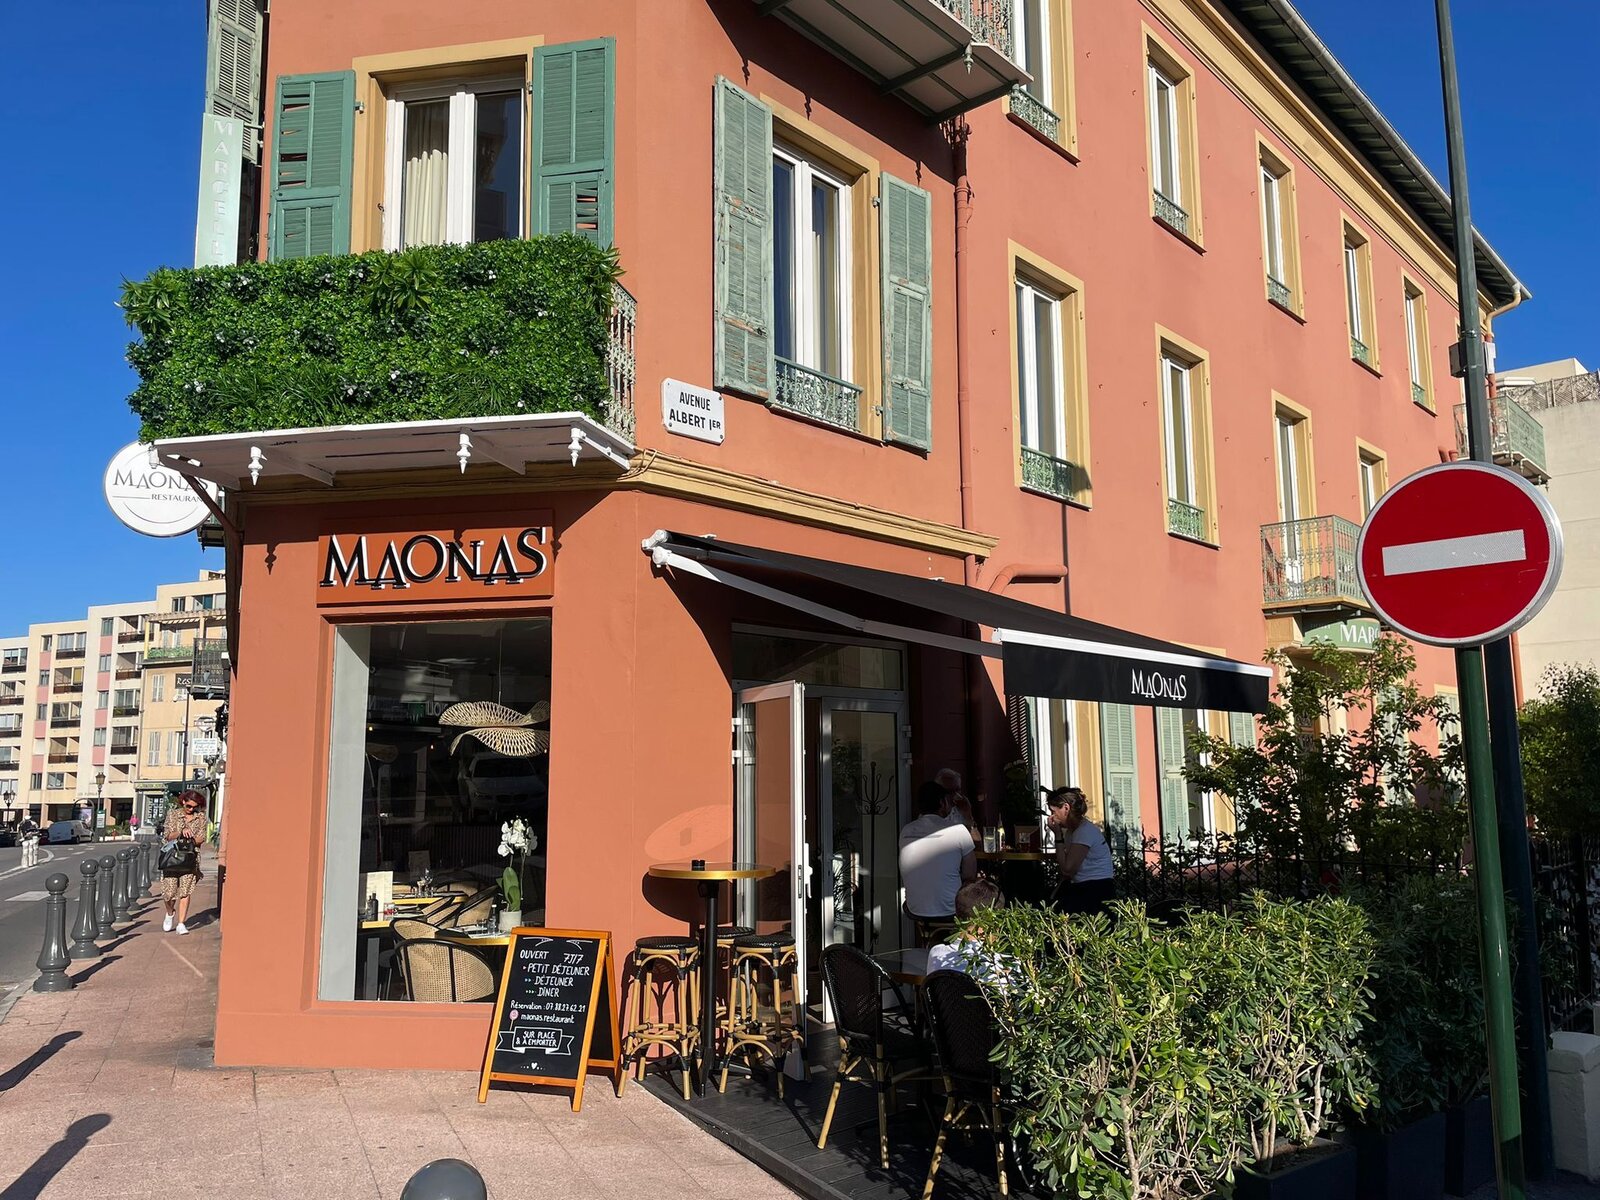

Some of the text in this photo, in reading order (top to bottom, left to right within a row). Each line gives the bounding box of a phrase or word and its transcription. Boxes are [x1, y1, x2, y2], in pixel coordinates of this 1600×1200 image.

[679, 391, 711, 412] AVENUE
[669, 408, 706, 429] ALBERT
[151, 493, 204, 503] RESTAURAN
[319, 526, 548, 590] MAONAS
[1131, 668, 1187, 701] MAONAS
[519, 949, 550, 960] OUVERT
[527, 962, 590, 976] PETIT DÉJEUNER
[534, 975, 574, 987] DÉJEUNER
[523, 1030, 556, 1039] SUR PLACE
[515, 1036, 521, 1045] &
[528, 1038, 557, 1048] EMPORTER
